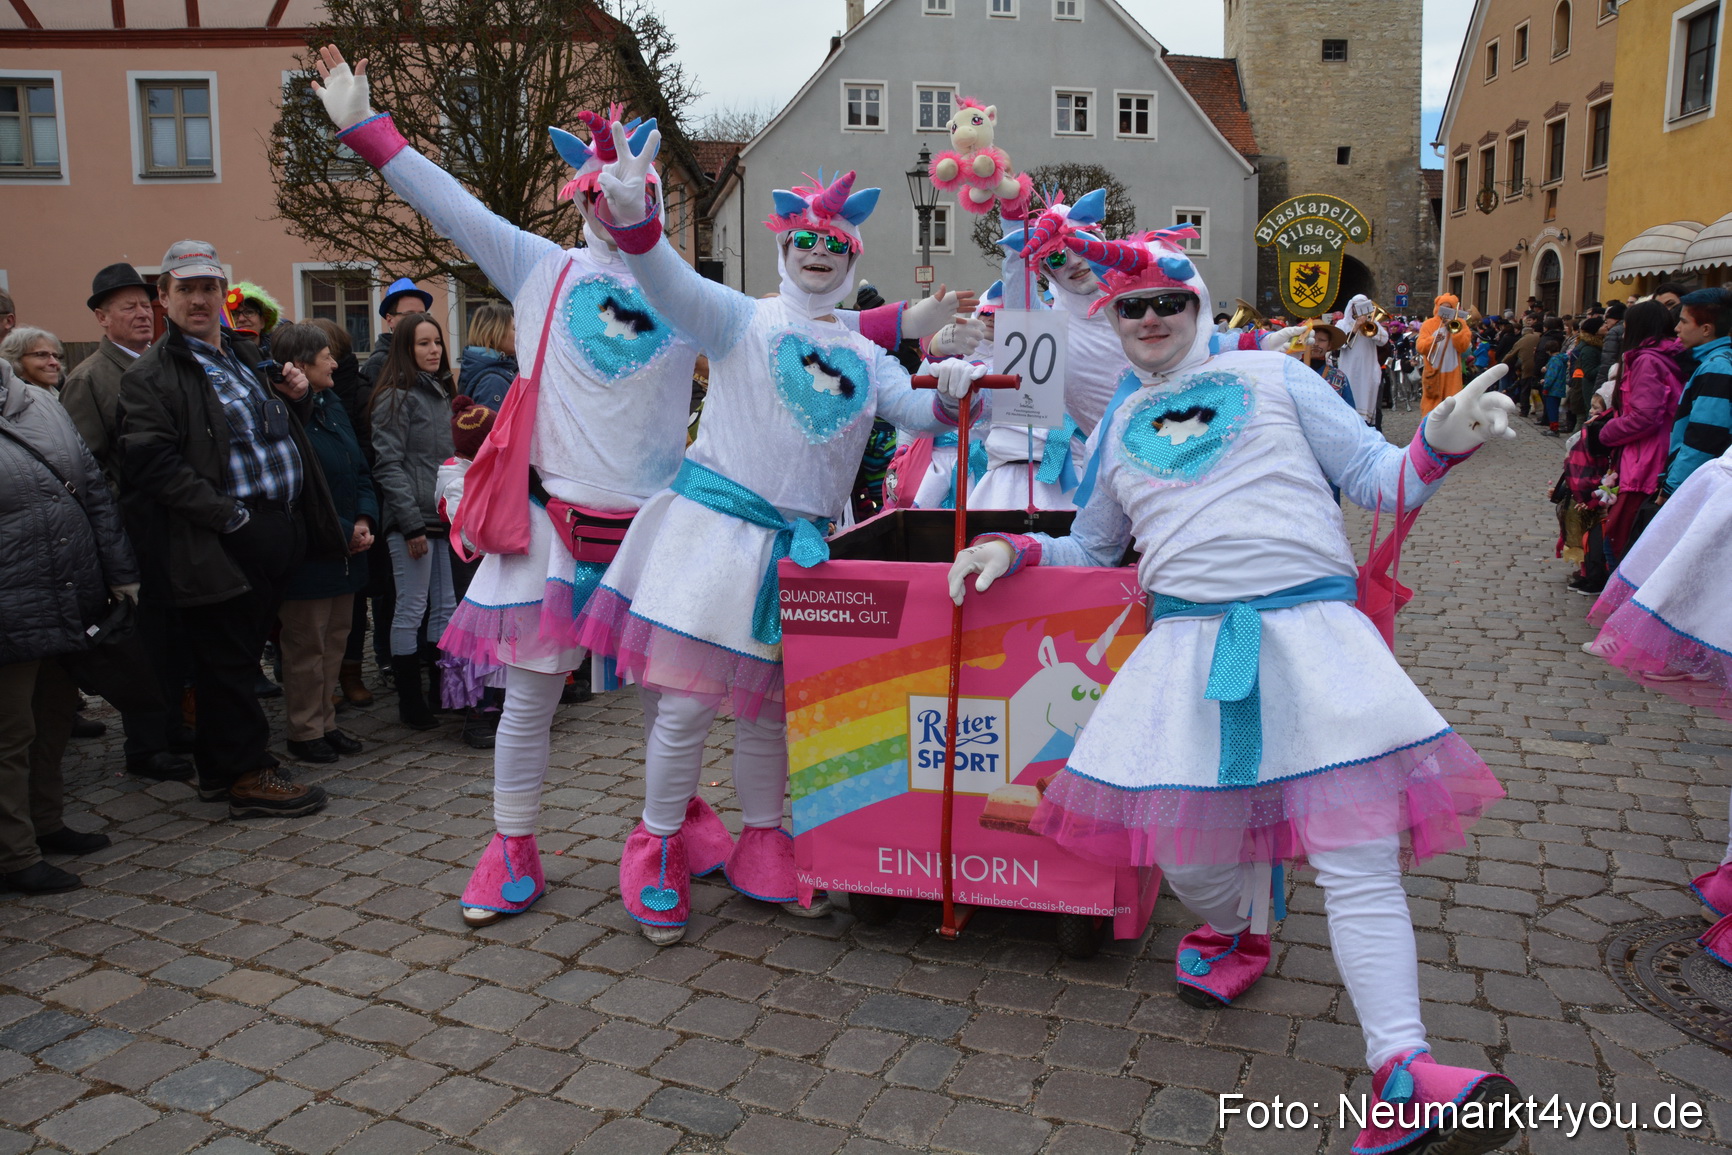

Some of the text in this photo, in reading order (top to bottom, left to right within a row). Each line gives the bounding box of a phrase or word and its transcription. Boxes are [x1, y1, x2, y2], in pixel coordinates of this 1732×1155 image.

[1256, 201, 1362, 243] Blaskapelle
[1277, 223, 1343, 250] Pilsach
[1298, 244, 1323, 255] 1954
[1002, 331, 1057, 385] 20
[779, 589, 877, 605] QUADRATISCH.
[780, 608, 890, 624] MAGISCH. GUT.
[917, 748, 1000, 773] SPORT
[878, 847, 1039, 888] EINHORN
[797, 872, 829, 889] Weiße
[832, 879, 894, 895] Schokolade
[897, 886, 913, 897] mit
[915, 887, 956, 902] Joght
[958, 890, 968, 903] &
